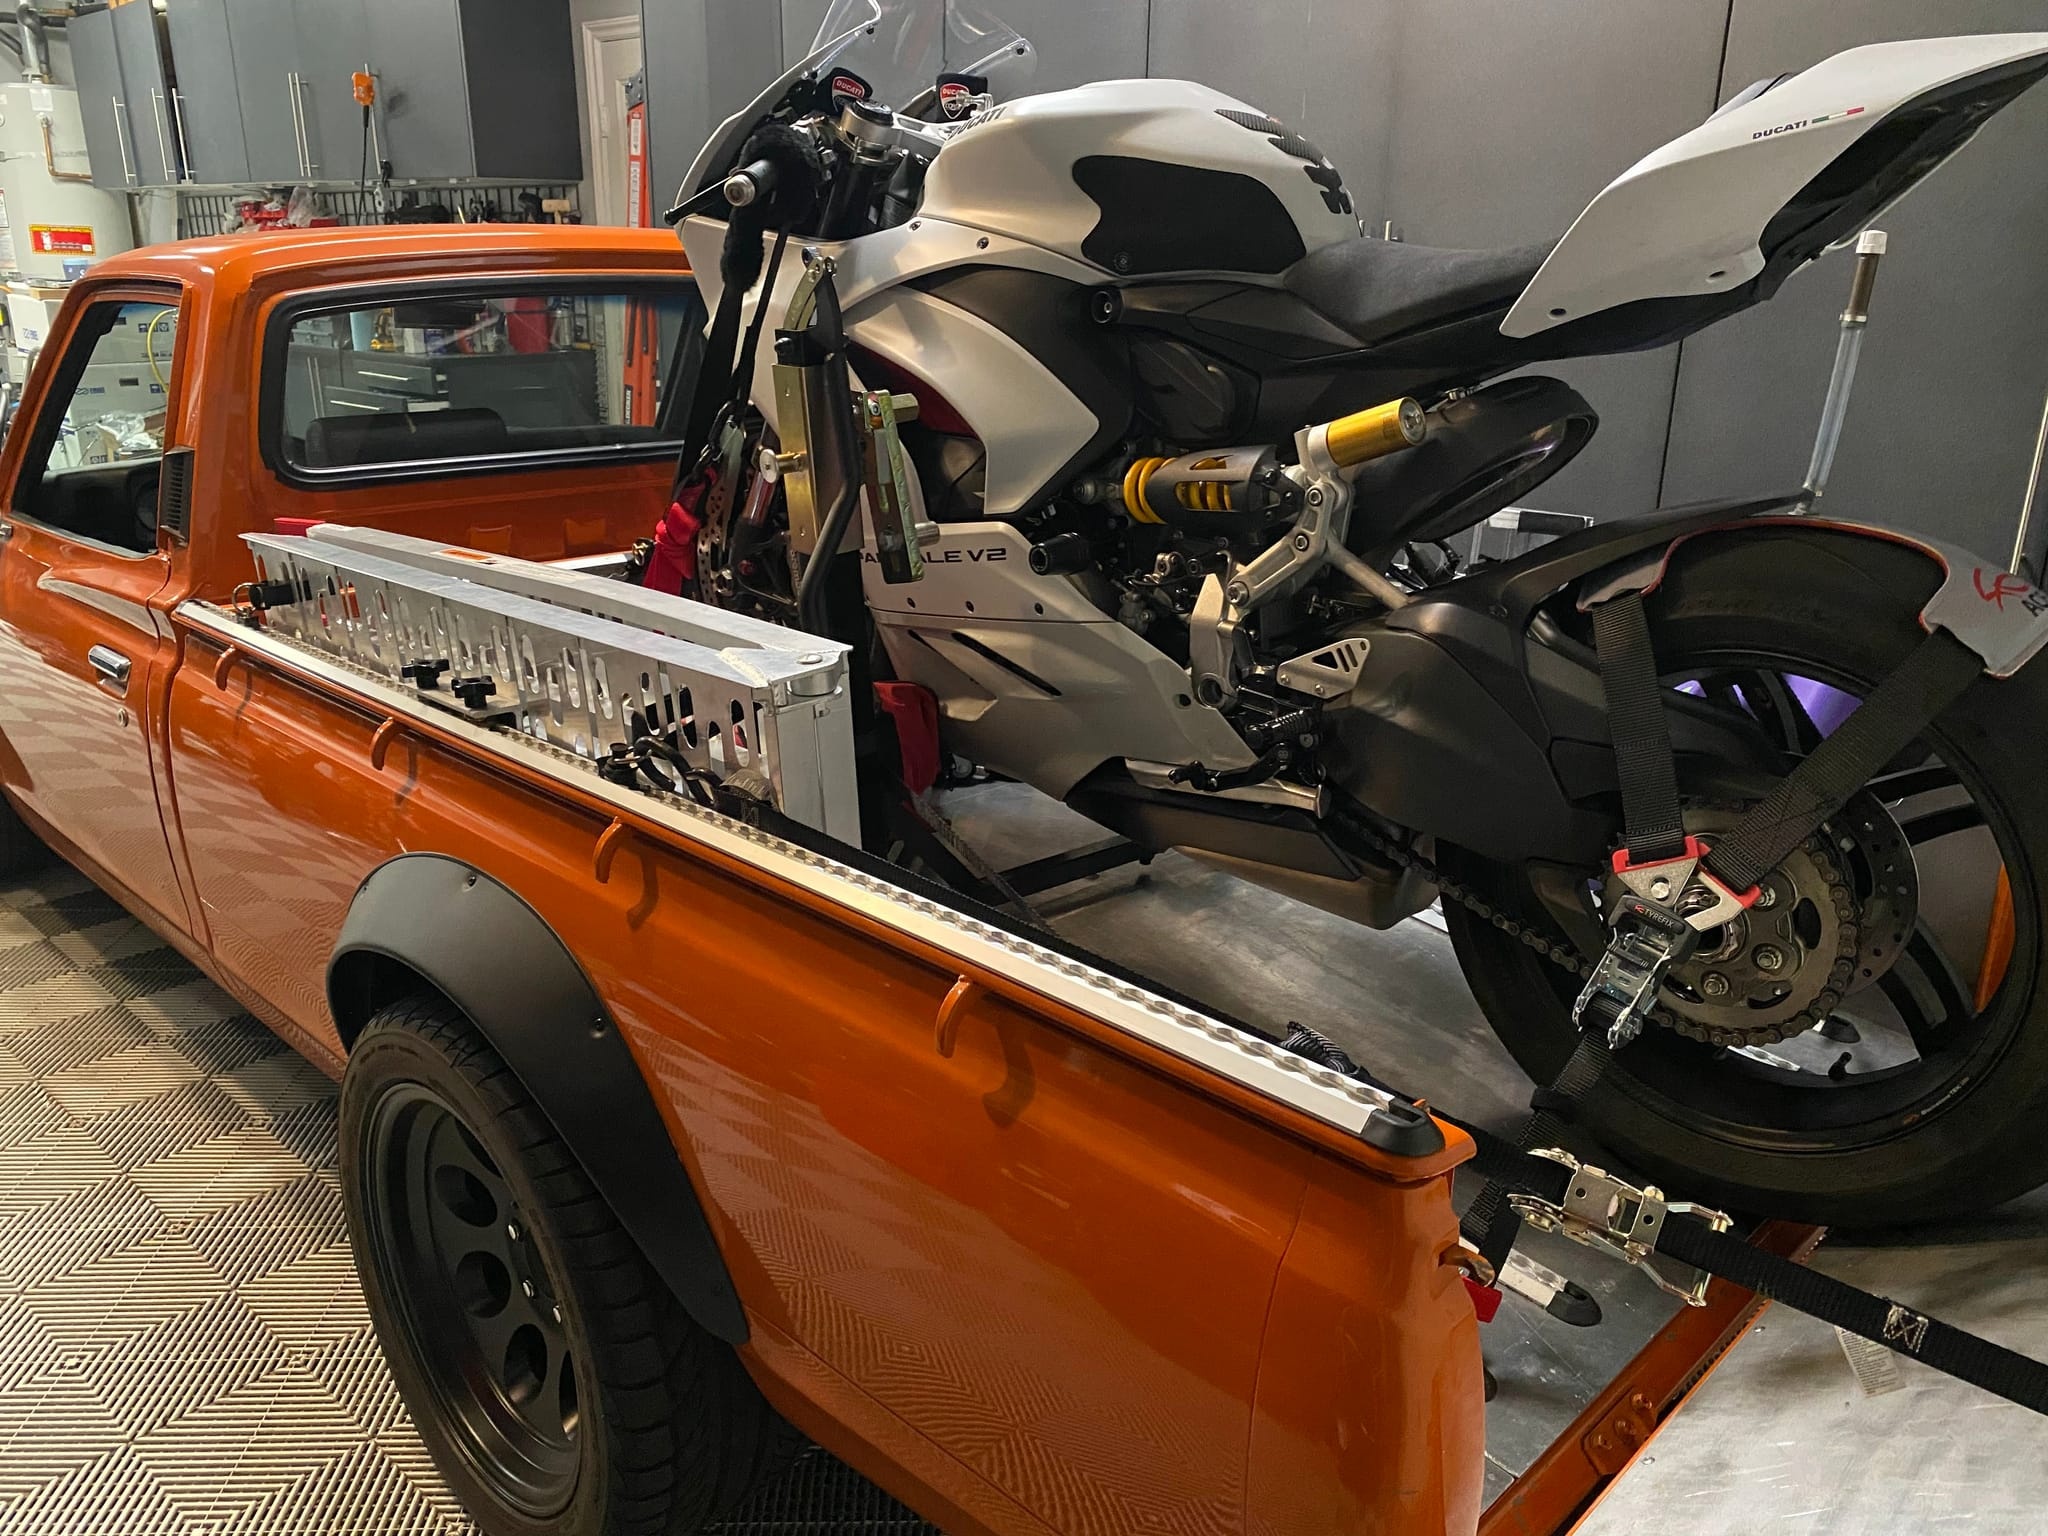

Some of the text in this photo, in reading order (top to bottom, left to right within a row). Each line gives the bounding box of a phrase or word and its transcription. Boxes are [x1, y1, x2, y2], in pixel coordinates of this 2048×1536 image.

[836, 79, 862, 96] DUCATI
[947, 106, 1007, 140] DUCATI
[1752, 119, 1808, 140] DUCATI
[967, 547, 1007, 562] V2
[1643, 908, 1675, 928] TYREFIX
